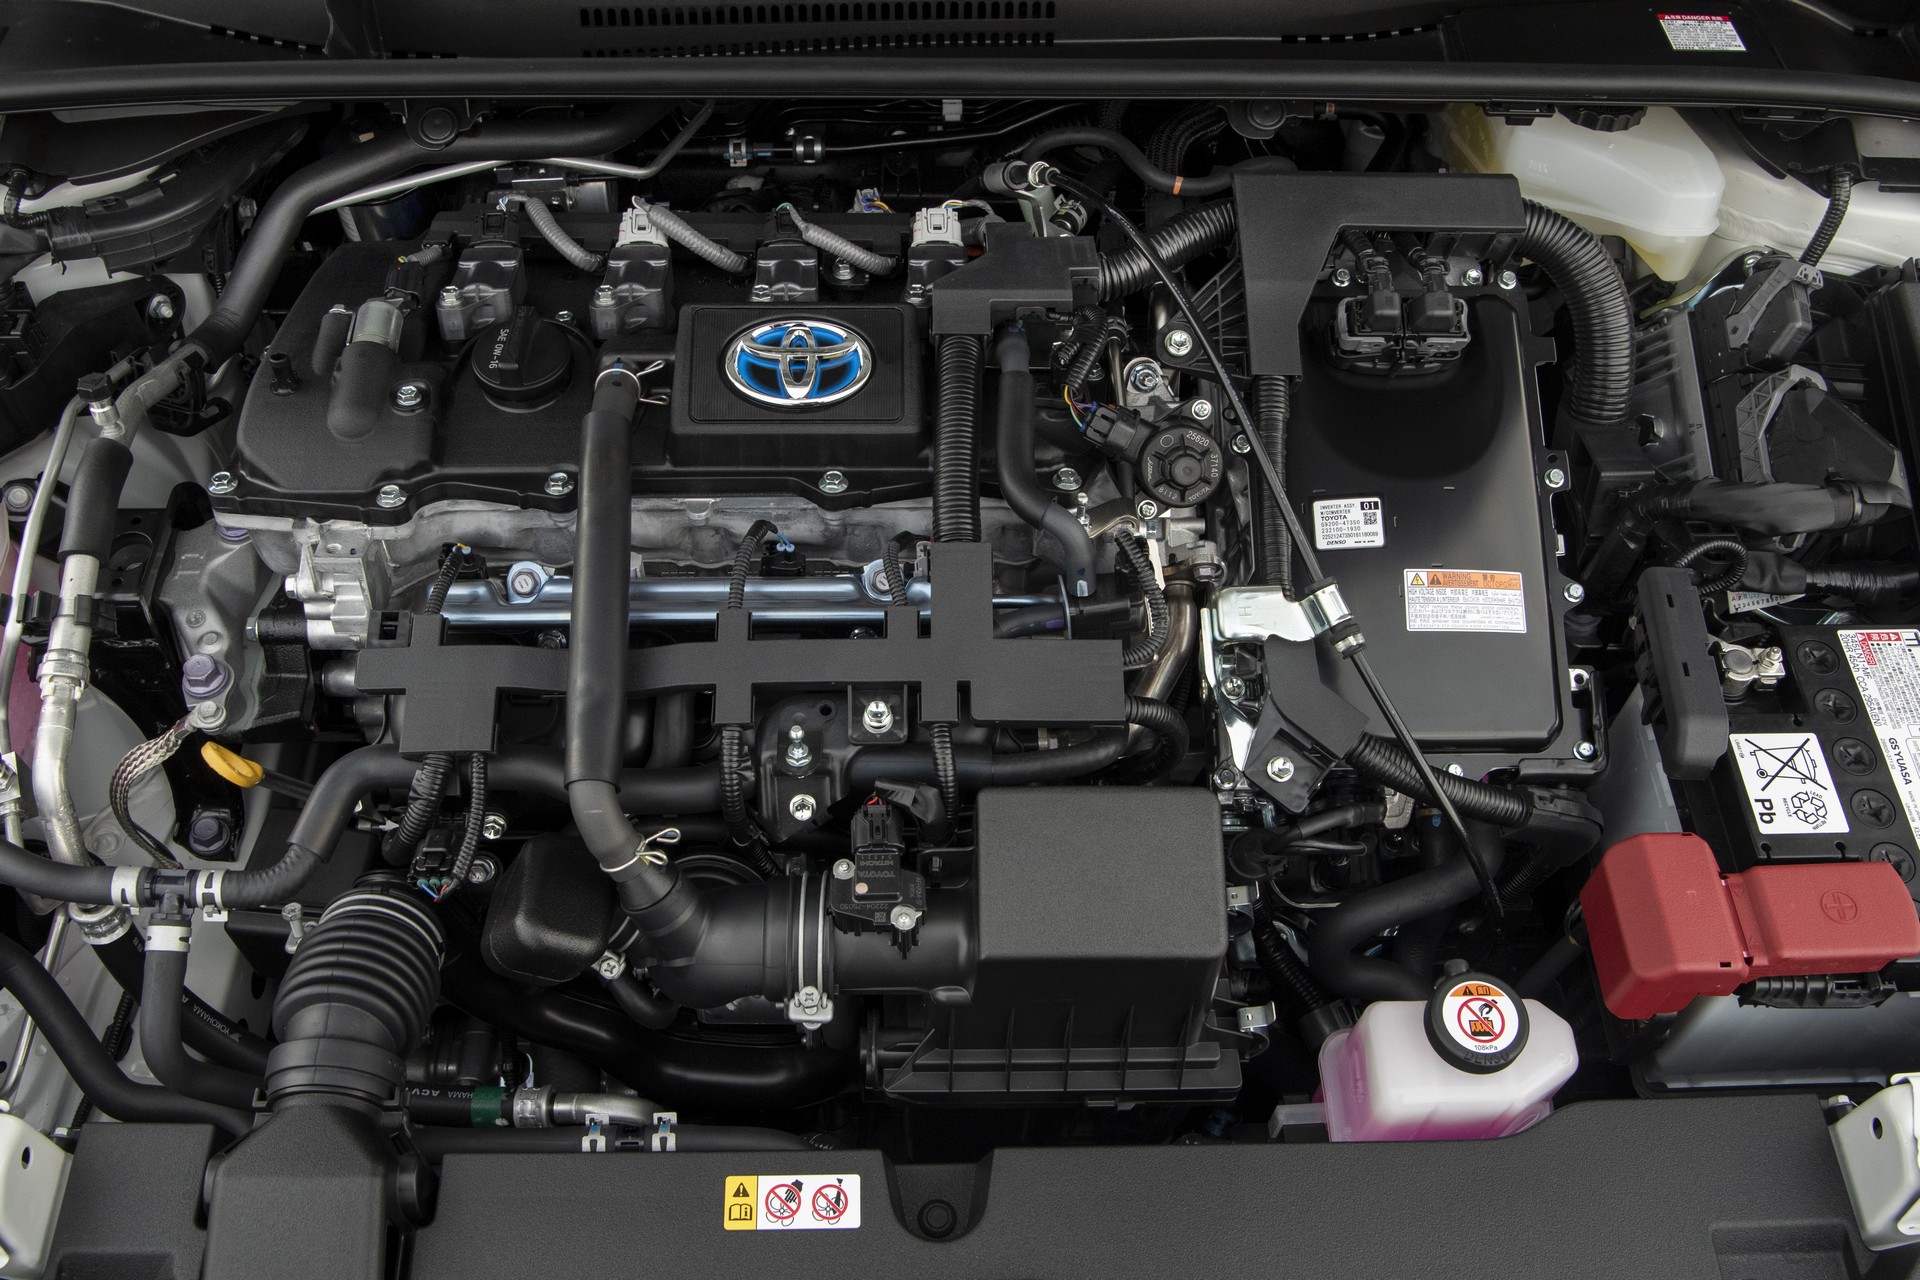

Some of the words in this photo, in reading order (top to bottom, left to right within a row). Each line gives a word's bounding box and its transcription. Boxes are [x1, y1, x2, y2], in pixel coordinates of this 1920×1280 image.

[497, 328, 510, 342] SAE
[488, 344, 504, 369] 0W-16
[1186, 430, 1210, 447] 25620
[1210, 453, 1219, 478] 37140
[1188, 486, 1210, 502] TOYOTA
[1363, 502, 1375, 510] 01
[1847, 633, 1872, 679] 345LN1-MF
[1859, 641, 1875, 664] DANGER
[1839, 633, 1853, 652] 20HR
[1847, 654, 1861, 672] 45Ah
[1855, 675, 1869, 691] CCA
[1862, 693, 1883, 726] 295A(EN)
[1887, 737, 1900, 749] GS
[1891, 750, 1913, 785] YUASA
[1809, 790, 1823, 799] LEAD
[1754, 798, 1776, 824] Pb
[1782, 797, 1793, 818] RECYCLE
[858, 870, 896, 878] TOYOTA
[193, 1004, 230, 1036] YOKOHAMA
[1464, 1050, 1510, 1065] DENSO
[411, 1088, 440, 1097] ACV
